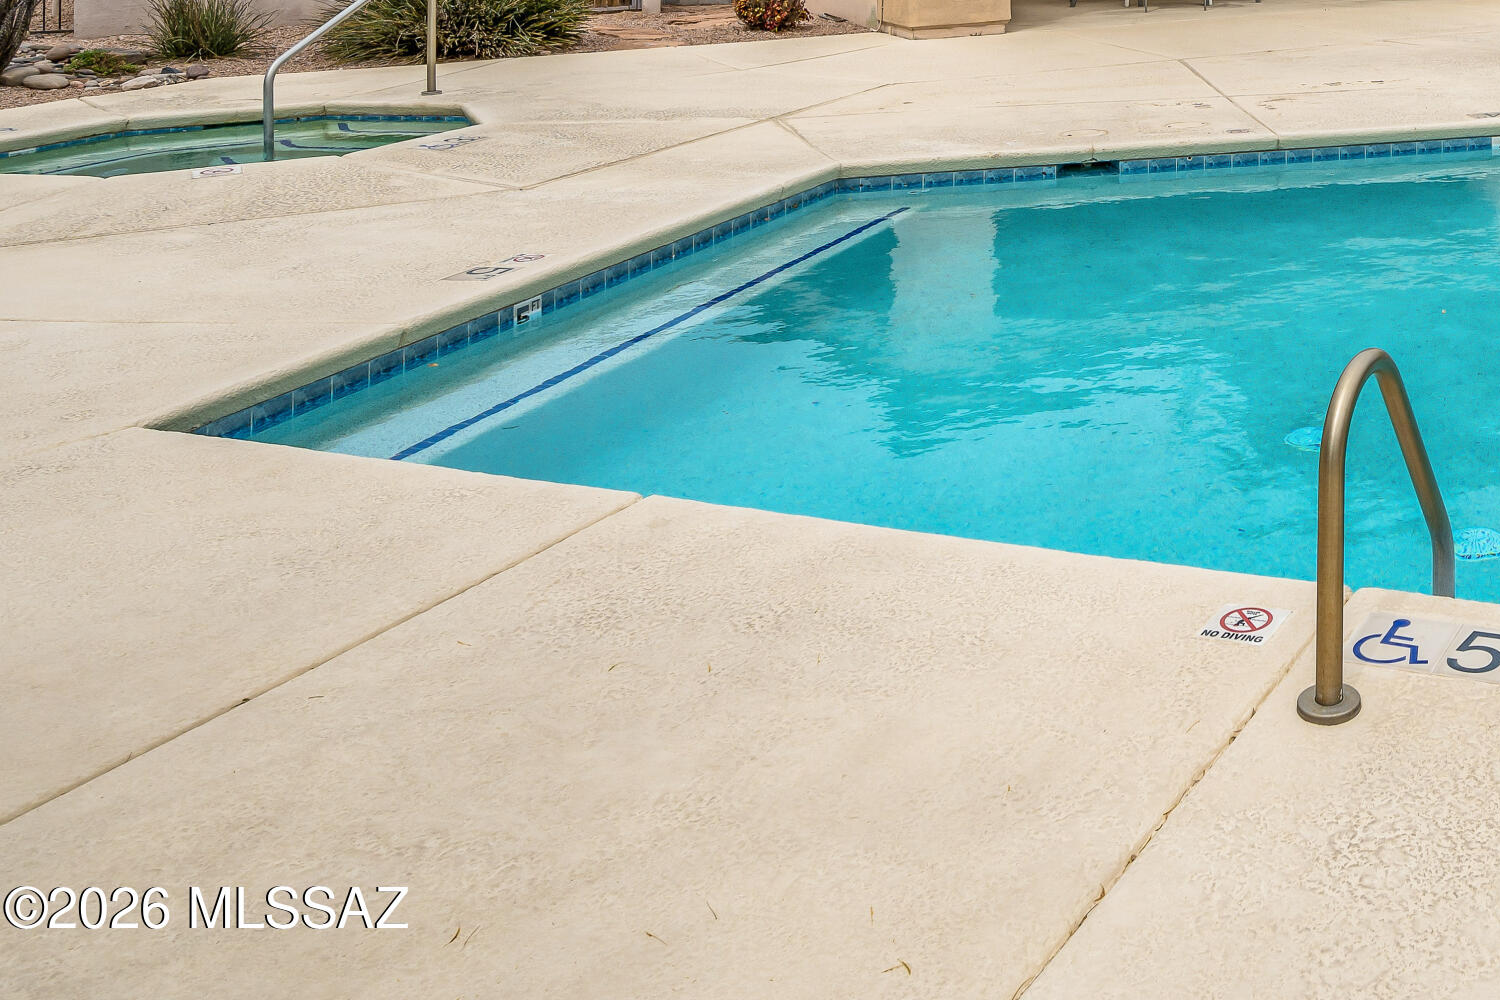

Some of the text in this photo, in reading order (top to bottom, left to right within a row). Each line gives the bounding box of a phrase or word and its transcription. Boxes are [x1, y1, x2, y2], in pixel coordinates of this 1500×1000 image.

[516, 299, 541, 325] 5 FT
[1200, 629, 1264, 643] NO DIVING
